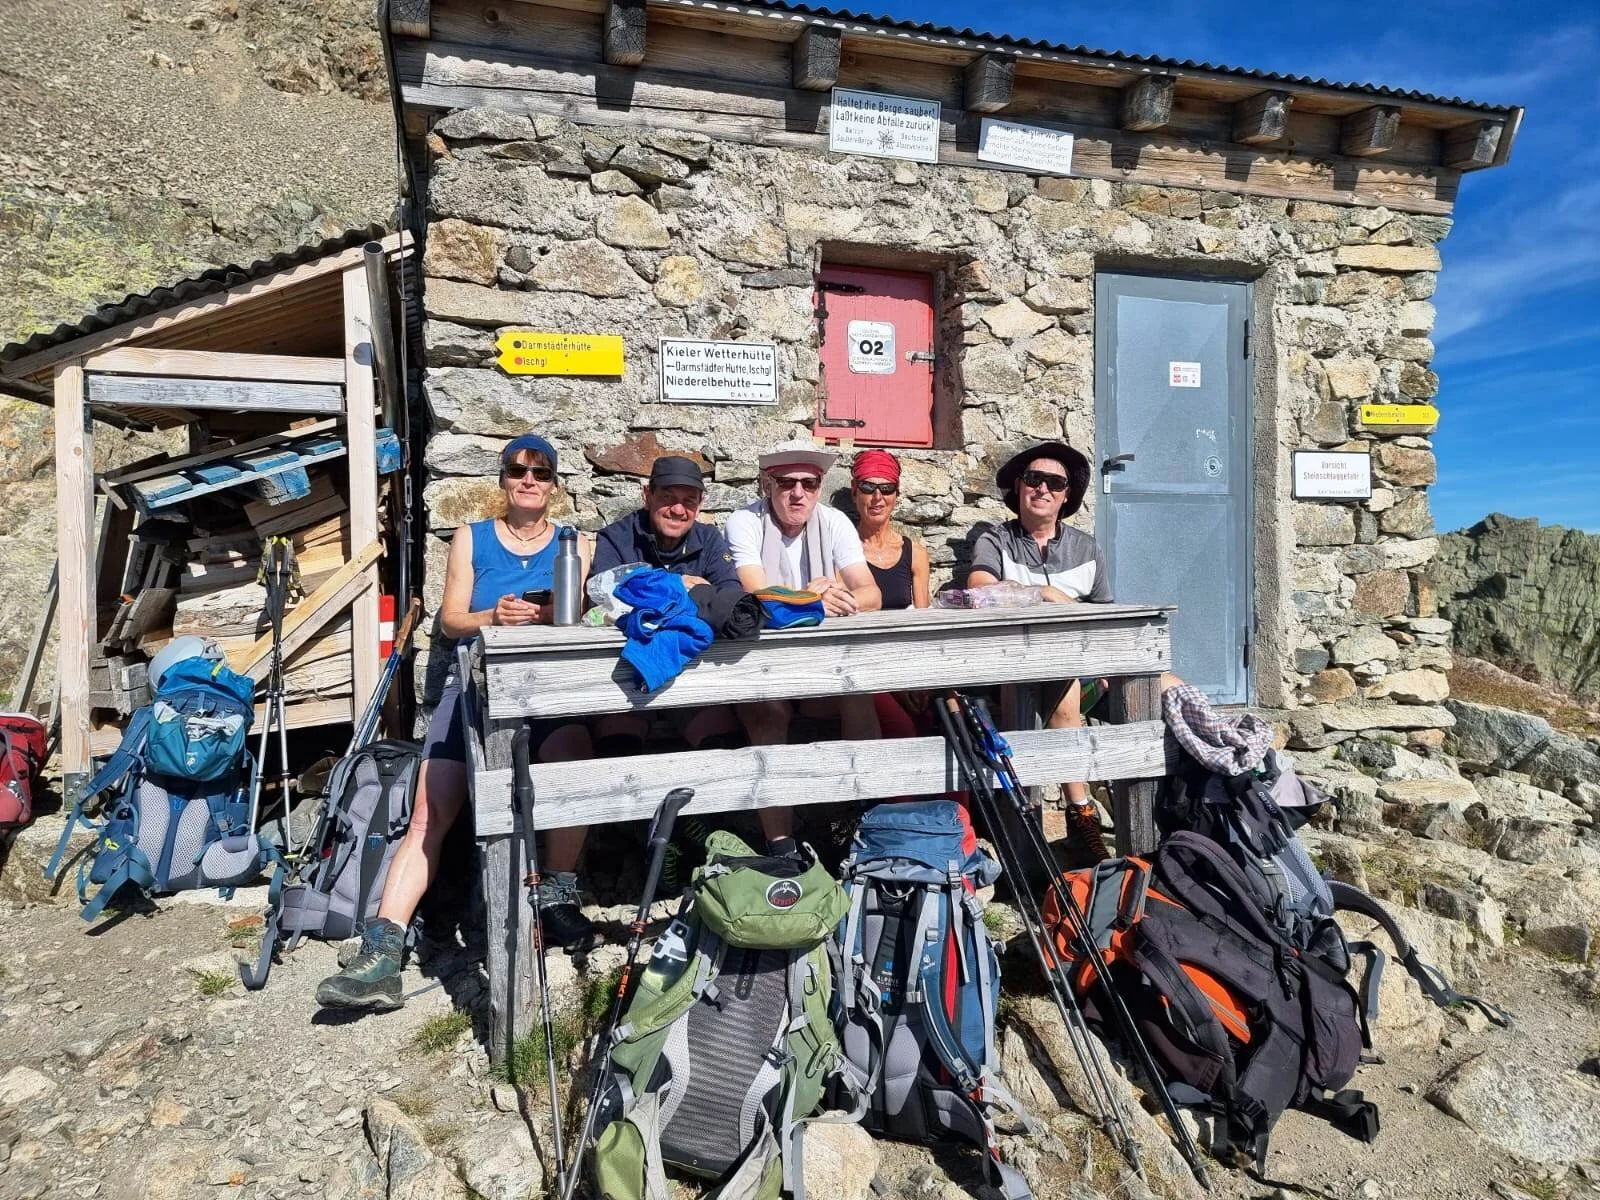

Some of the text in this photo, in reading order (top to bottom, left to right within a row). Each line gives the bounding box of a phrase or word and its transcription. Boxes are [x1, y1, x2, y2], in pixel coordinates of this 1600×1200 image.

[837, 96, 862, 110] Haltet
[864, 100, 876, 110] die
[879, 102, 902, 116] Berge
[836, 110, 852, 120] Laßt
[854, 113, 874, 124] keine
[666, 346, 771, 360] Kieler Wetterhütte
[676, 361, 725, 372] Darmstädter
